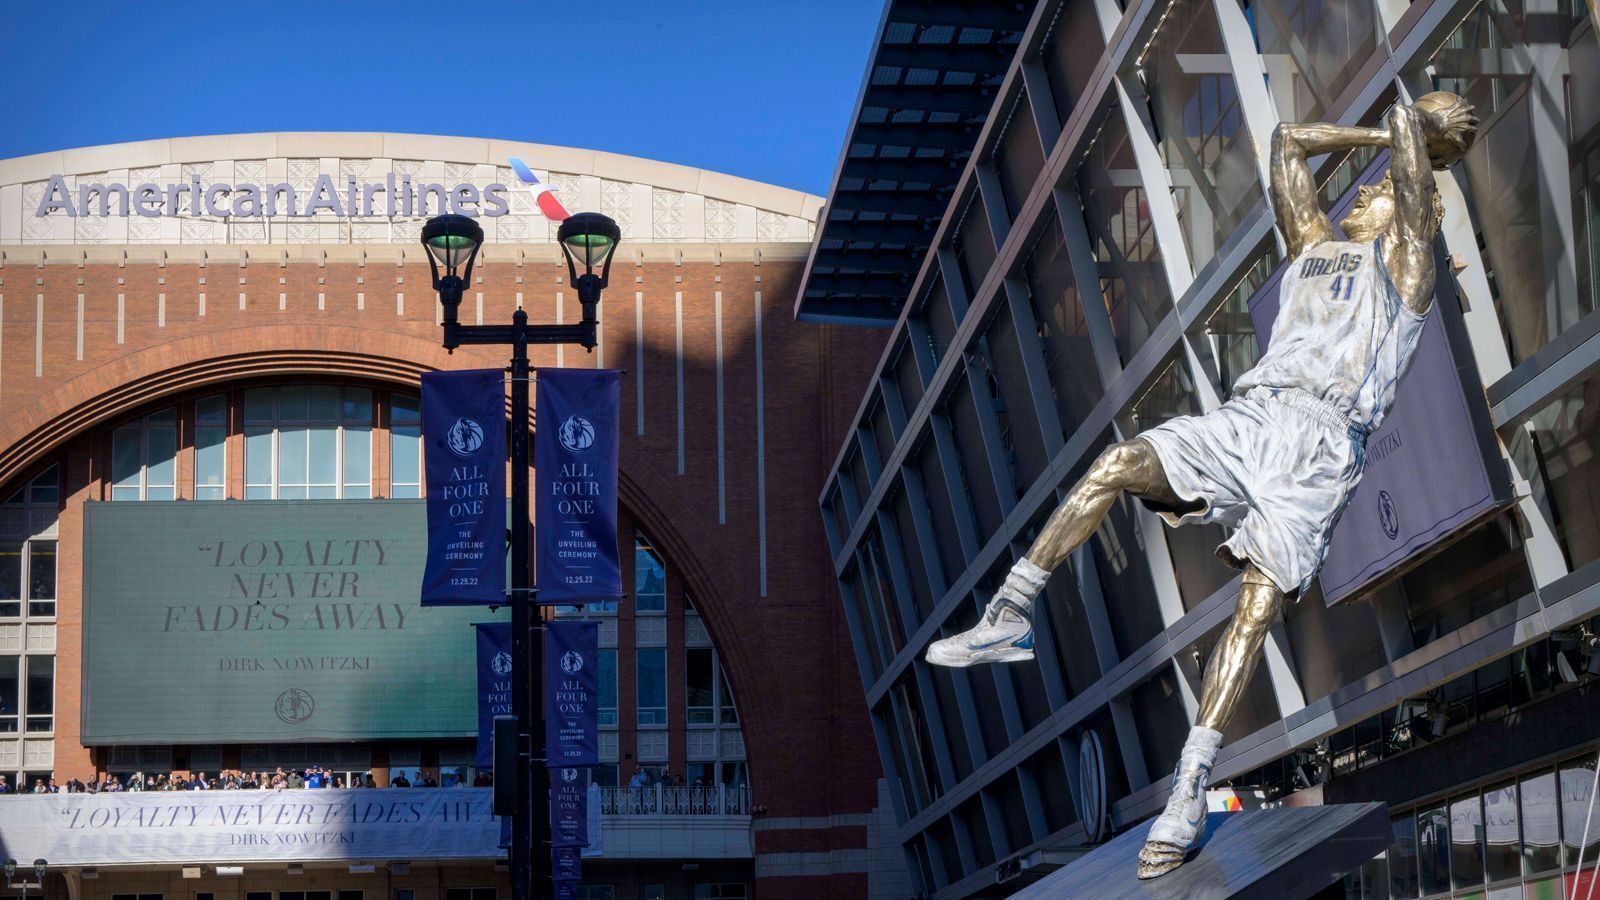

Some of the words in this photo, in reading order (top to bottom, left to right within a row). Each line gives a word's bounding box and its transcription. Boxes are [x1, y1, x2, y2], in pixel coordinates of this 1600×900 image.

[36, 174, 296, 217] American
[303, 172, 510, 218] Airlines
[1299, 253, 1363, 279] DALLAS
[1328, 274, 1355, 301] 41
[449, 465, 483, 482] ALL
[559, 463, 594, 477] ALL
[443, 482, 489, 500] FOUR
[552, 481, 600, 496] FOUR
[449, 500, 484, 518] ONE
[558, 500, 594, 515] ONE
[570, 530, 584, 538] THE
[447, 542, 484, 550] UNVEILING
[445, 552, 484, 560] CEREMONY
[558, 551, 597, 559] CEREMONY
[227, 571, 361, 600] NEVER
[450, 578, 478, 586] 12.25.22
[565, 576, 593, 584] 12.25.22
[159, 602, 290, 633] FADES
[219, 657, 265, 673] DIRK
[272, 656, 371, 671] NOWITZKI
[560, 680, 584, 690] ALL
[488, 693, 512, 703] FOU
[556, 692, 587, 702] FOUR
[559, 703, 584, 713] ONE
[210, 803, 315, 827] NEVER
[322, 802, 425, 824] FADES
[426, 801, 495, 823] AWA
[231, 834, 270, 846] DIRK
[275, 832, 355, 845] NOWITZKI
